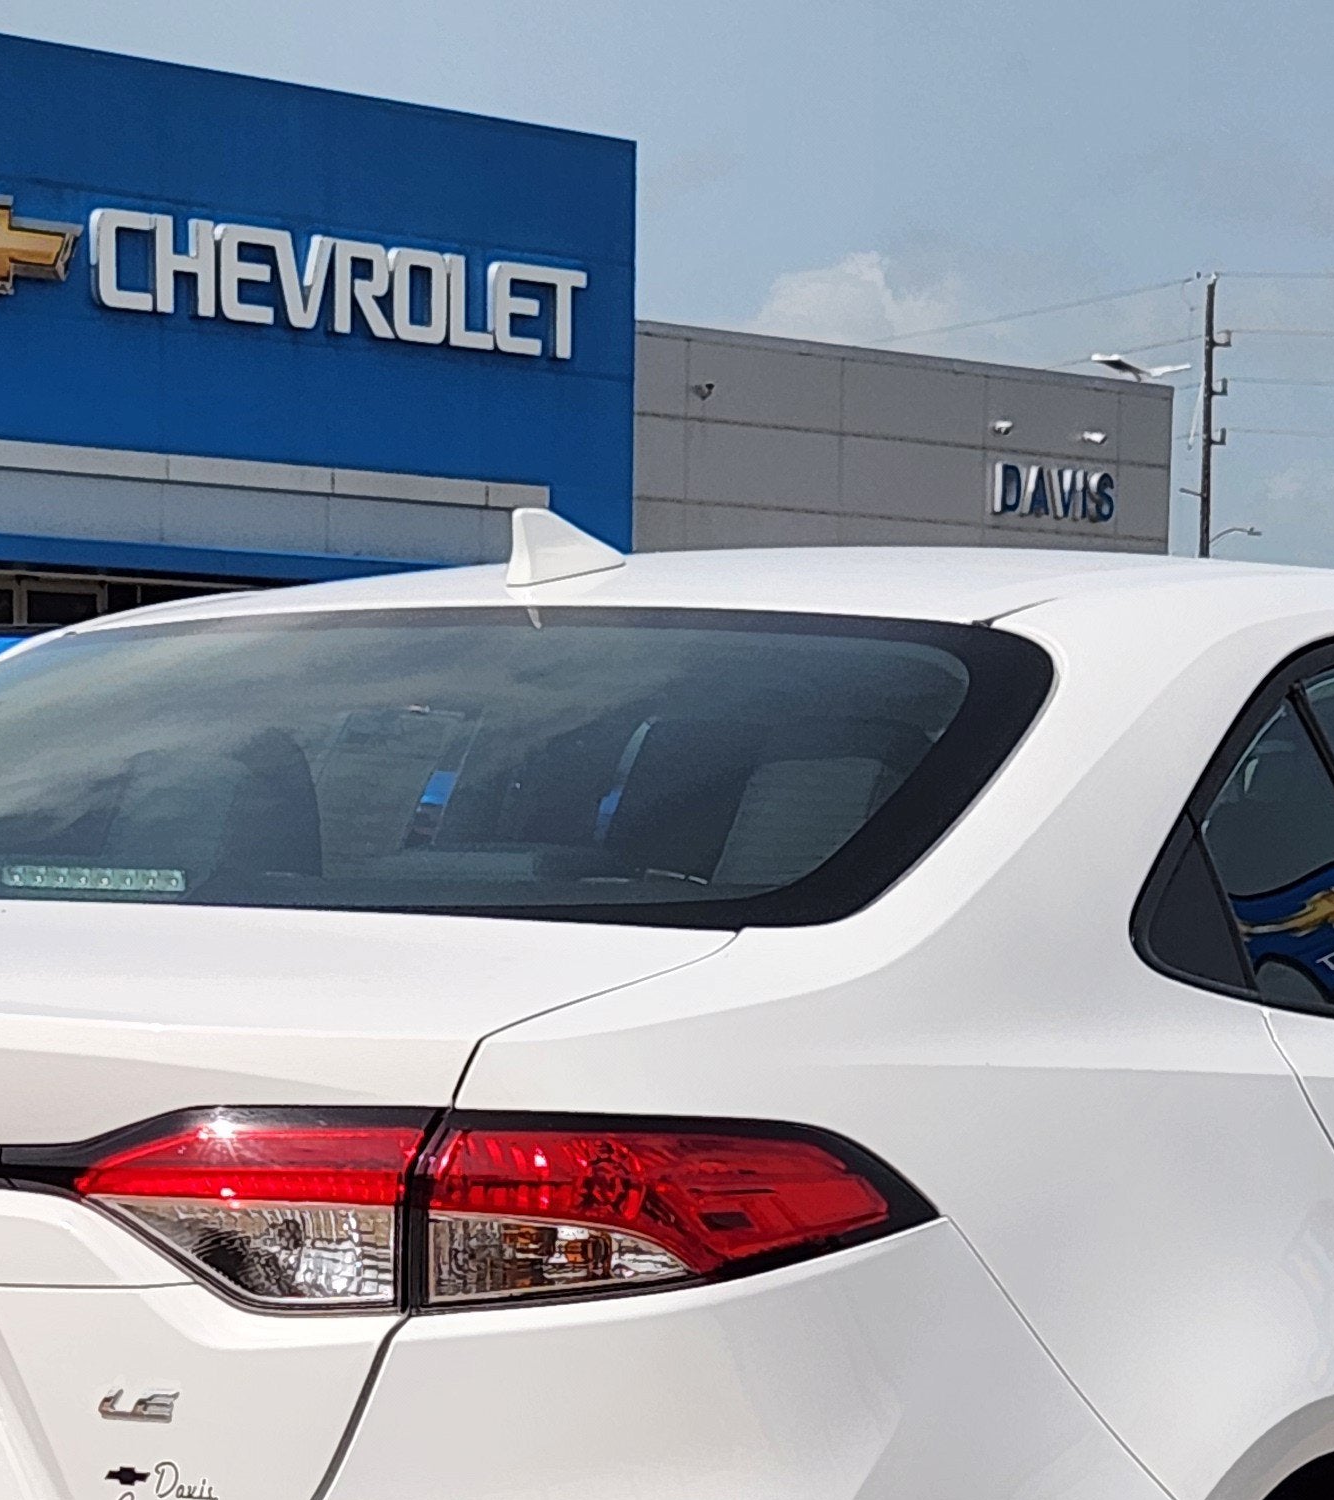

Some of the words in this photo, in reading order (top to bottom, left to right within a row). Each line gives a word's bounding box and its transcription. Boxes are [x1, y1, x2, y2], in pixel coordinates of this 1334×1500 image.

[88, 206, 588, 360] CHEVROLET
[991, 462, 1115, 523] DAVIS
[98, 1388, 181, 1424] LE
[154, 1461, 219, 1500] Davis
